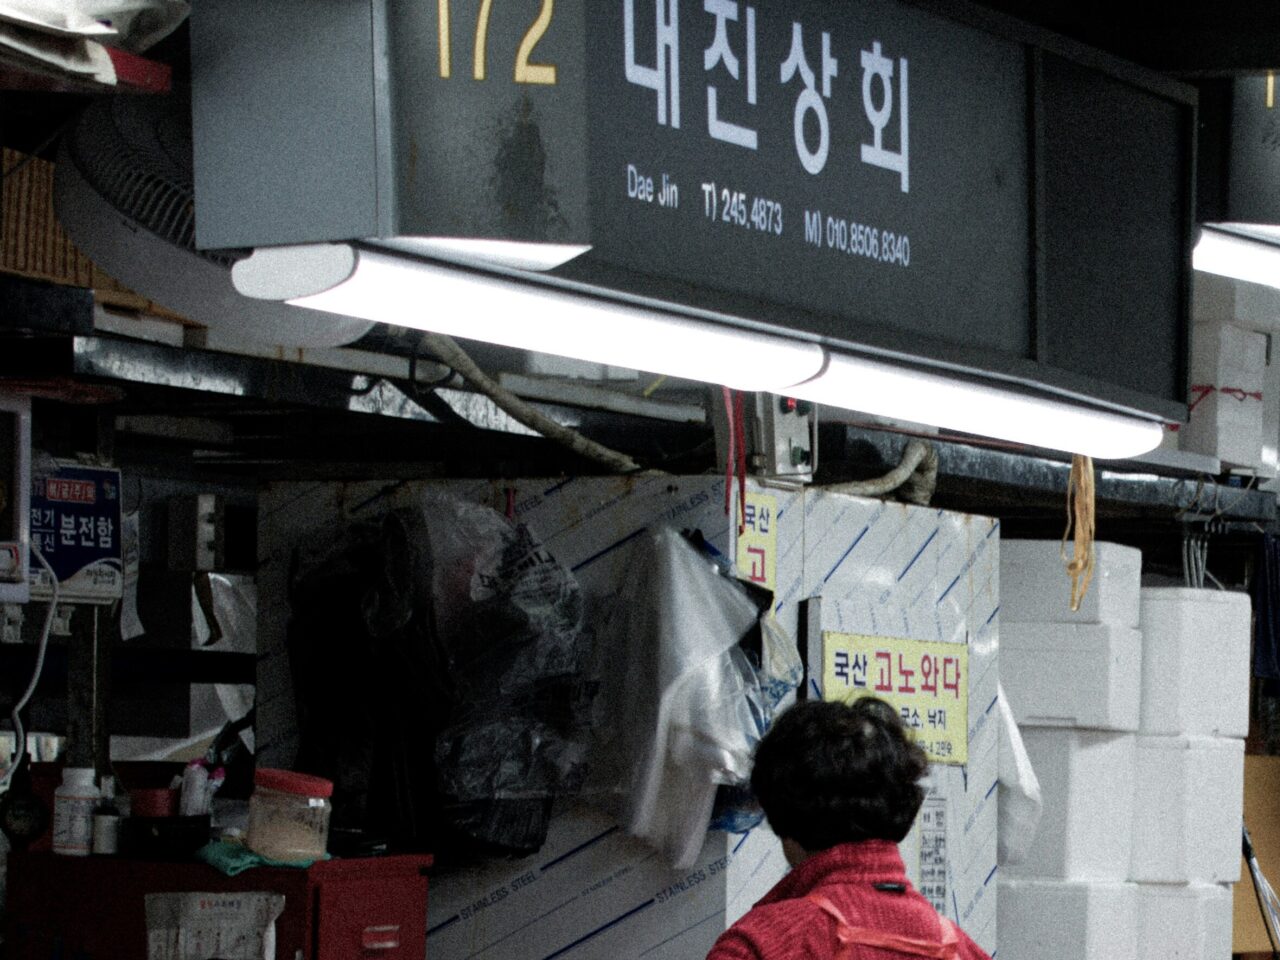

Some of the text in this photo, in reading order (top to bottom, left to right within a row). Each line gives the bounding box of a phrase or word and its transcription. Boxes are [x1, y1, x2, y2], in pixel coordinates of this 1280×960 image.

[624, 0, 911, 194] 대진상회
[626, 163, 655, 205] Dae
[657, 173, 680, 210] Jin
[59, 513, 115, 550] 분전함
[747, 547, 767, 584] 고
[834, 651, 961, 700] 국산 고노와다
